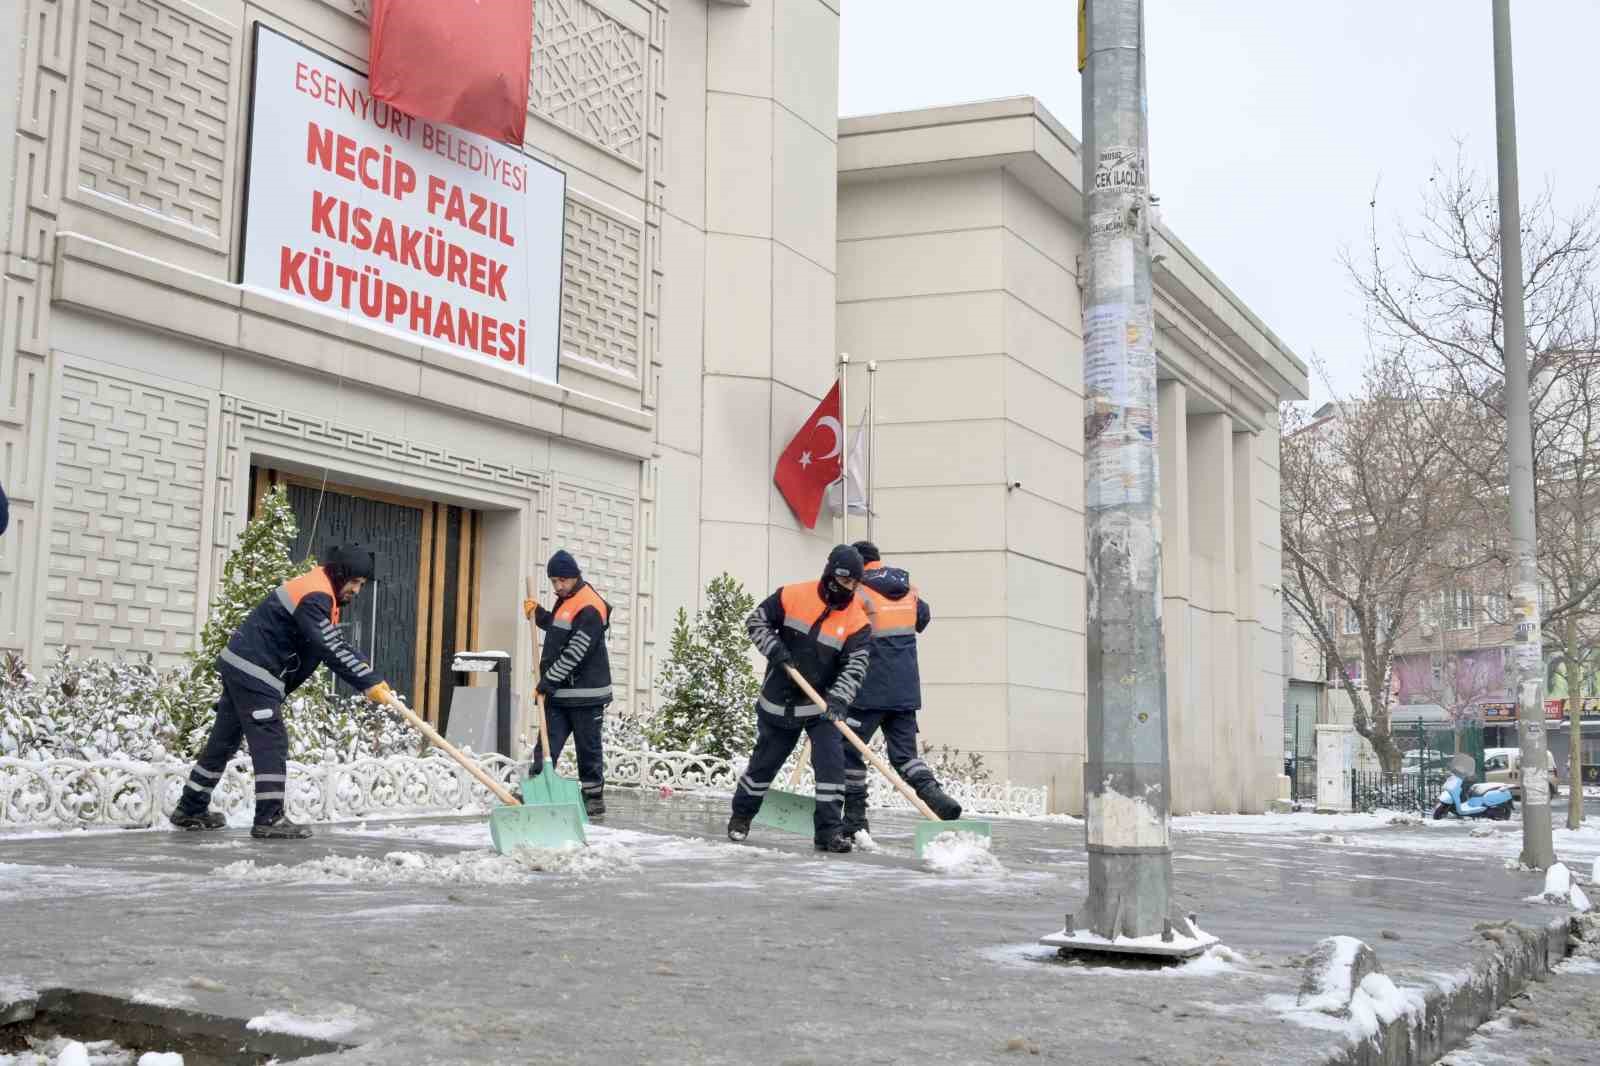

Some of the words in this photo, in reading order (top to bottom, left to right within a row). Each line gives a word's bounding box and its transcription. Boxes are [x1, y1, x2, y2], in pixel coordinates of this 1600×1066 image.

[294, 62, 416, 141] ESENYURT
[422, 123, 528, 194] BELEDİYESİ
[306, 121, 417, 201] NECİP
[427, 174, 515, 247] FAZIL
[279, 246, 526, 365] KÜTÜPHANESİ
[311, 190, 508, 301] KISAKÜREK
